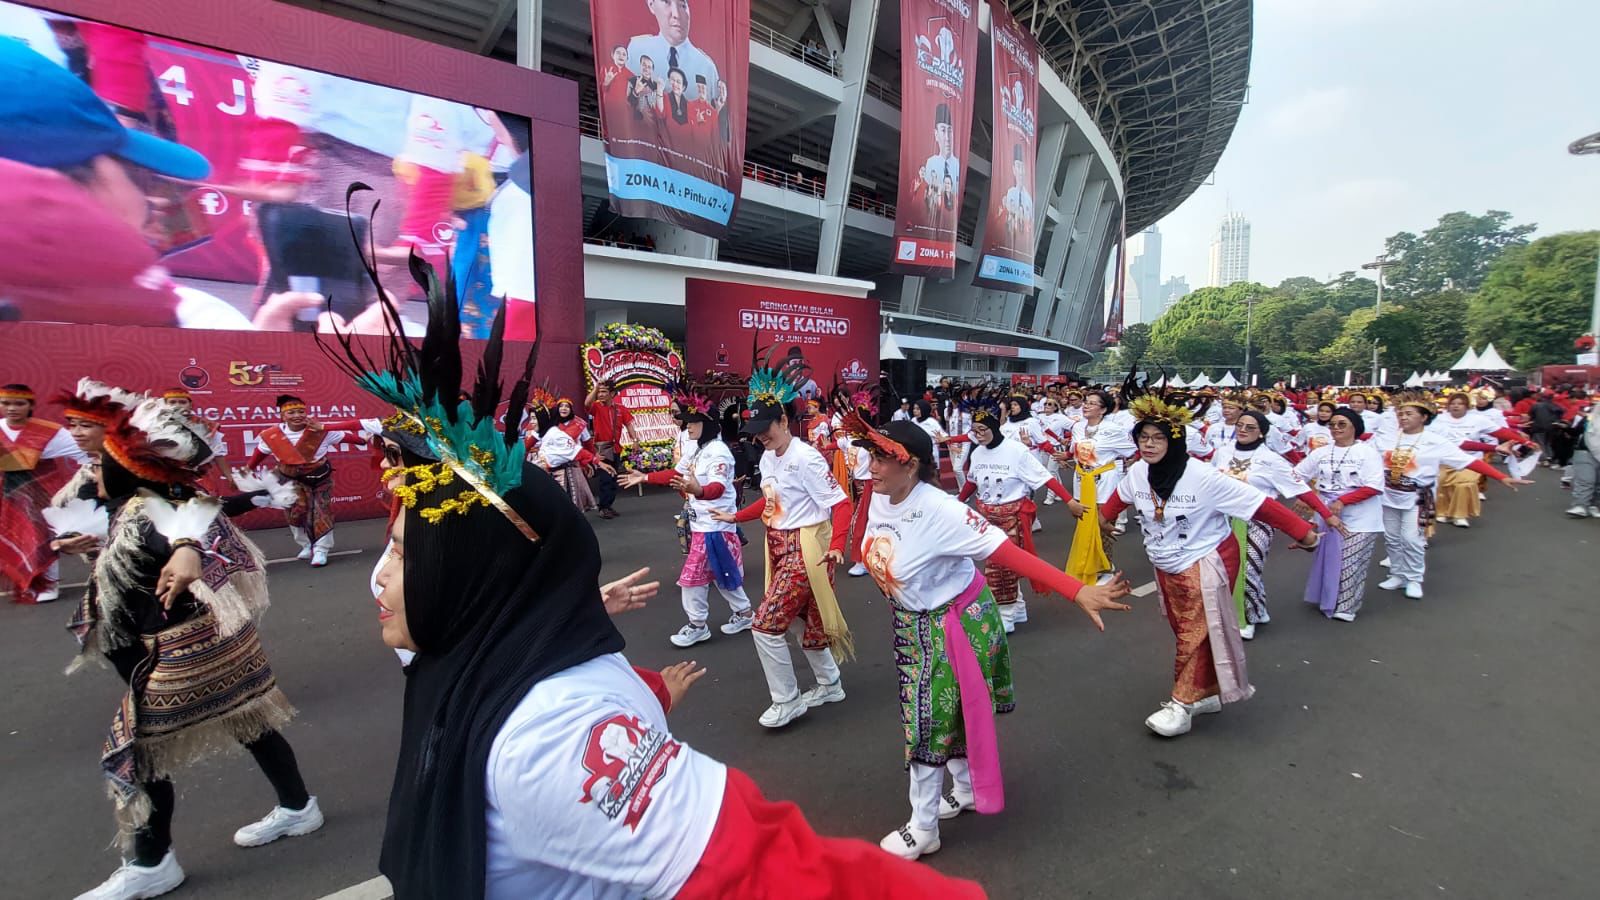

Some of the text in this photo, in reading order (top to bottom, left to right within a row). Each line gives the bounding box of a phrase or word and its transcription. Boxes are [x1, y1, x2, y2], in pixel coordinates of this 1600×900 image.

[157, 64, 194, 106] 4
[625, 173, 660, 190] ZONA
[663, 180, 676, 197] 1A
[684, 187, 707, 204] Pintu
[707, 197, 718, 209] 47
[920, 247, 940, 259] ZONA
[999, 265, 1014, 275] ZONA
[760, 300, 834, 316] PERINGATAN BULAN
[742, 312, 848, 336] BUNG KARNO
[775, 334, 821, 345] 24 JUNI 2023
[190, 405, 356, 421] NGATAN ULAN
[608, 771, 641, 819] TANGAN
[898, 825, 917, 848] ior
